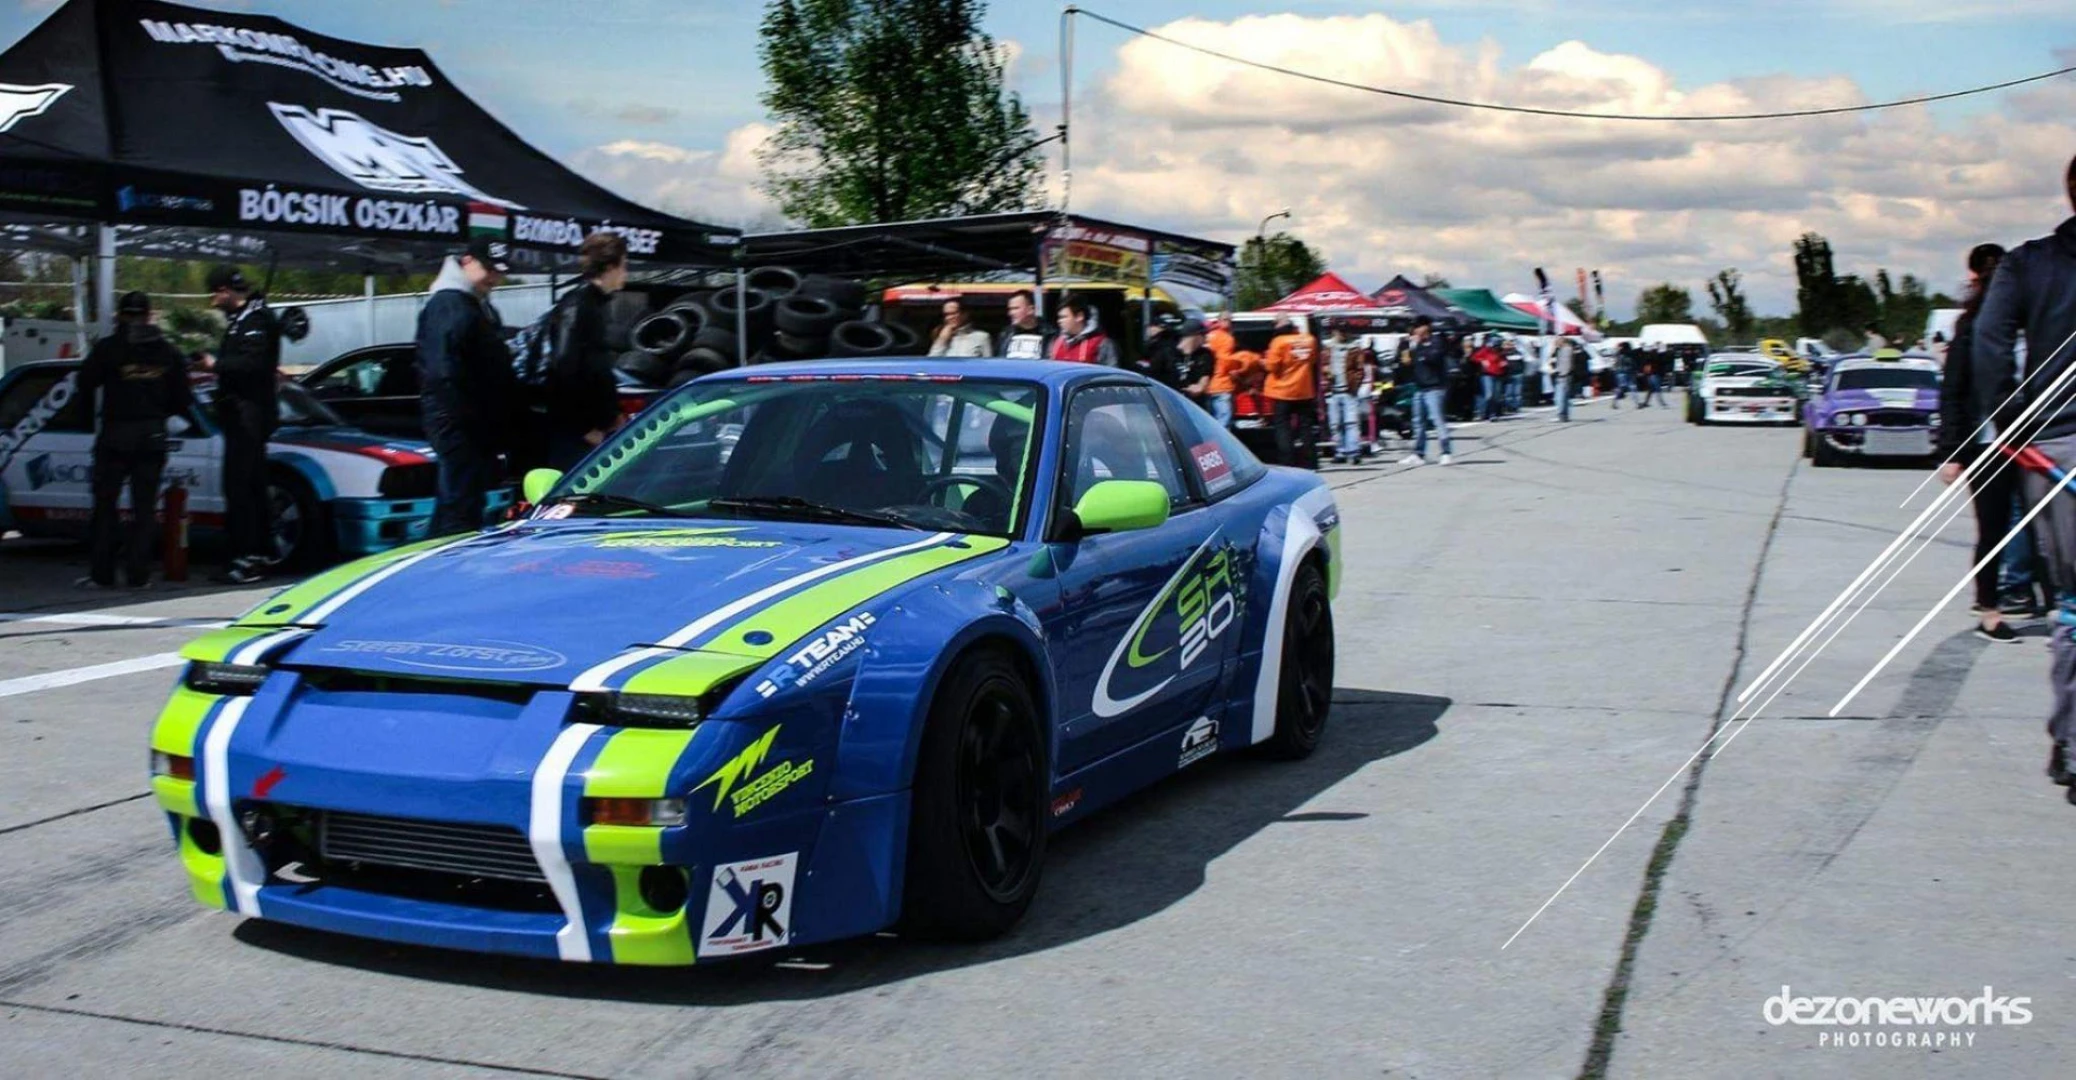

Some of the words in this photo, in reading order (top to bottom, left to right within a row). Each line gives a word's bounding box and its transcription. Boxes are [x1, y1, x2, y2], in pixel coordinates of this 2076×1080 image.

[239, 183, 350, 226] BÓCSIK
[355, 200, 460, 233] OSZKÁR
[733, 758, 815, 819] MOTORSPORT
